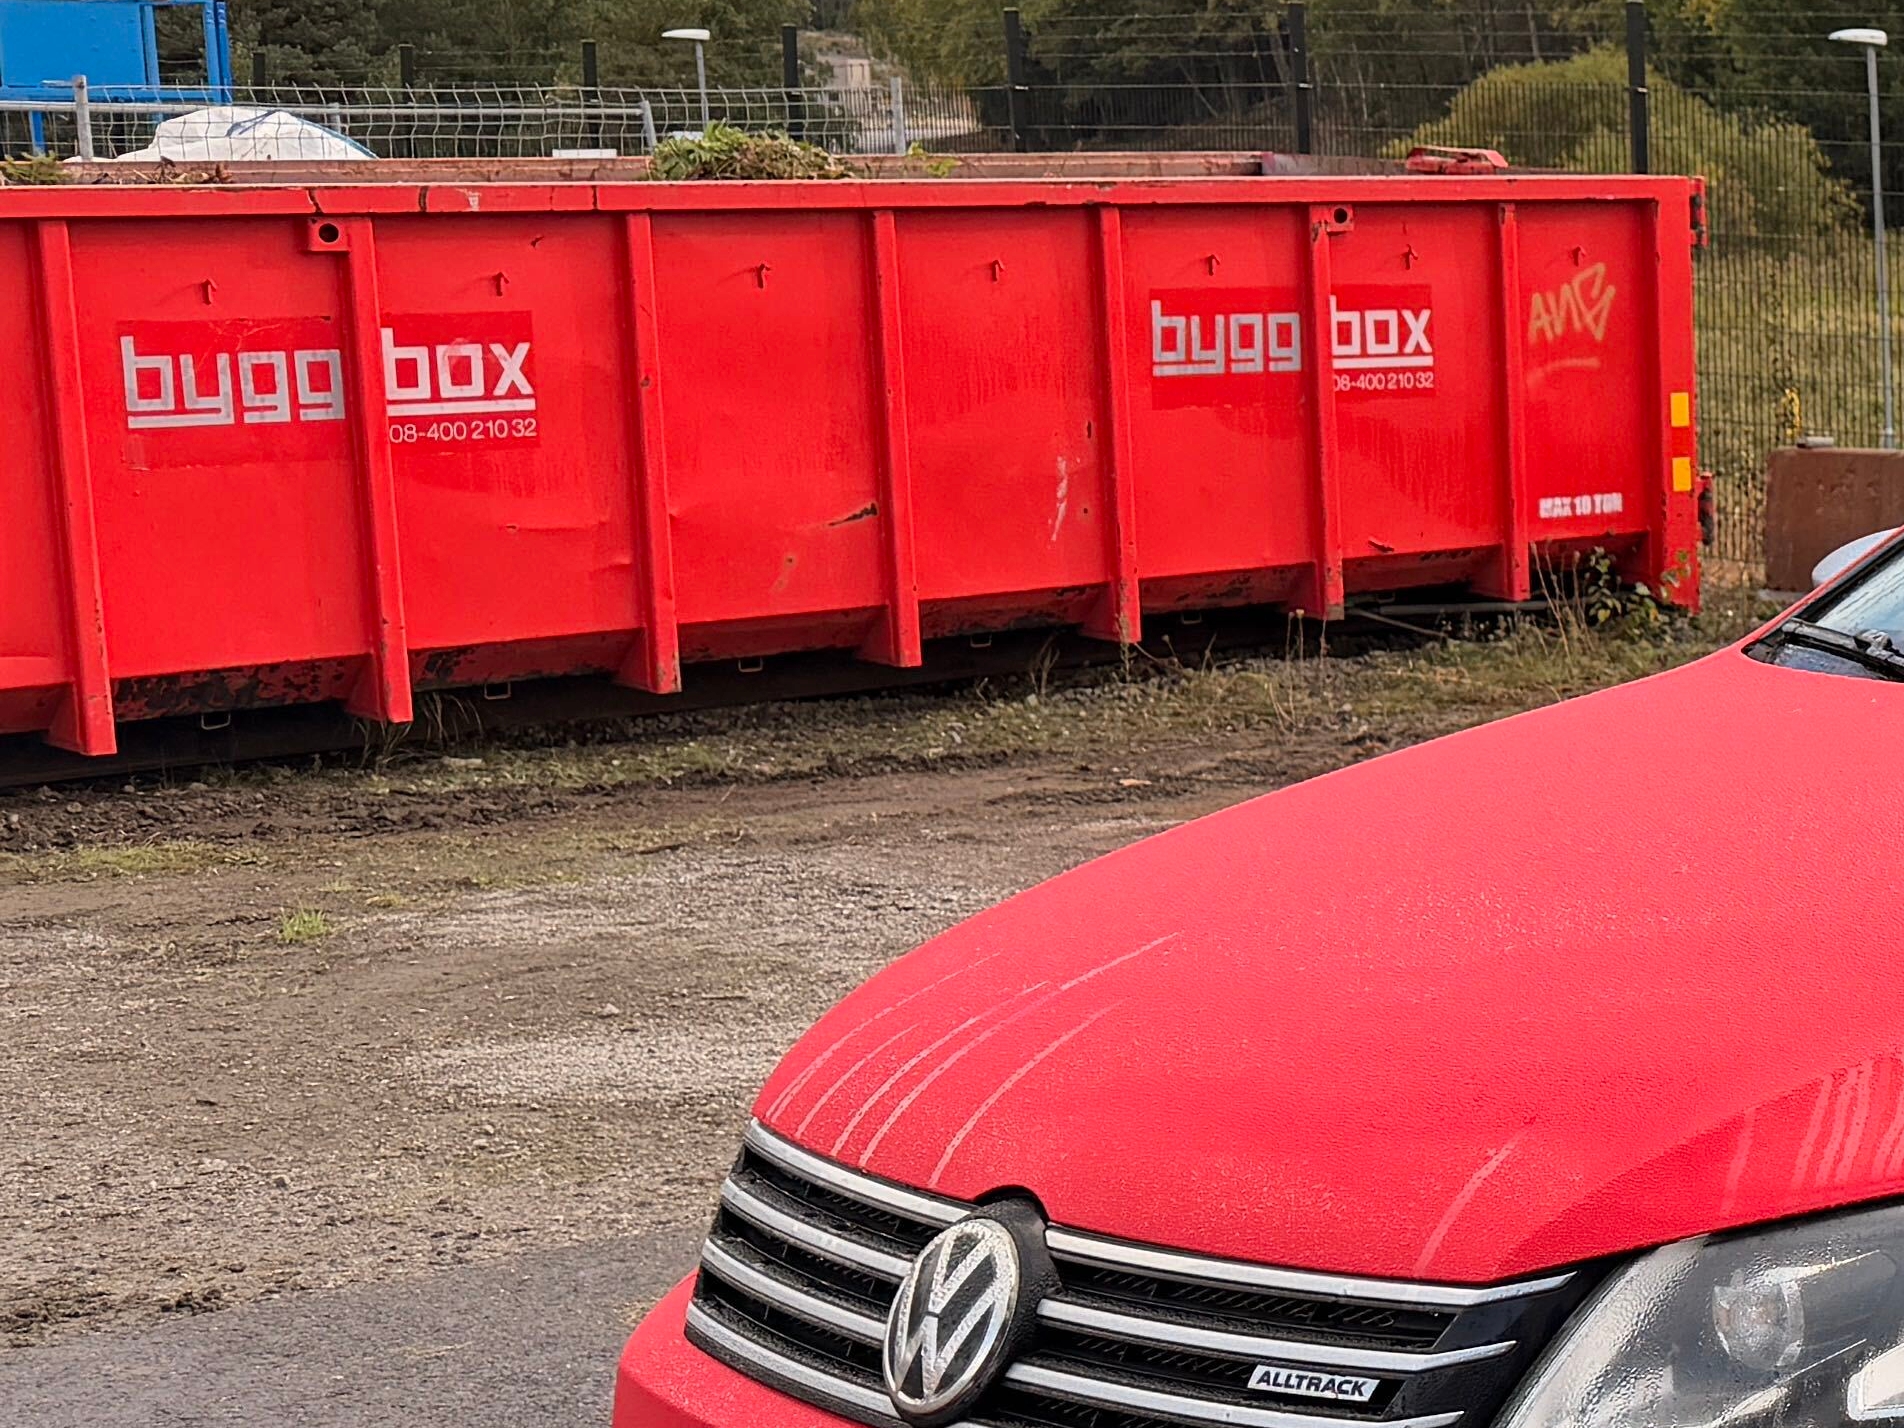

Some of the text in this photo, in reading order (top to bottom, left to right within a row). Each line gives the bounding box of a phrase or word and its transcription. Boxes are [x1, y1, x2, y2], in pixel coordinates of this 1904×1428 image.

[1150, 294, 1433, 377] bygg box
[119, 326, 535, 430] bygg box
[388, 417, 538, 444] 08-400 210 32
[1255, 1369, 1368, 1398] ALLTRACK
